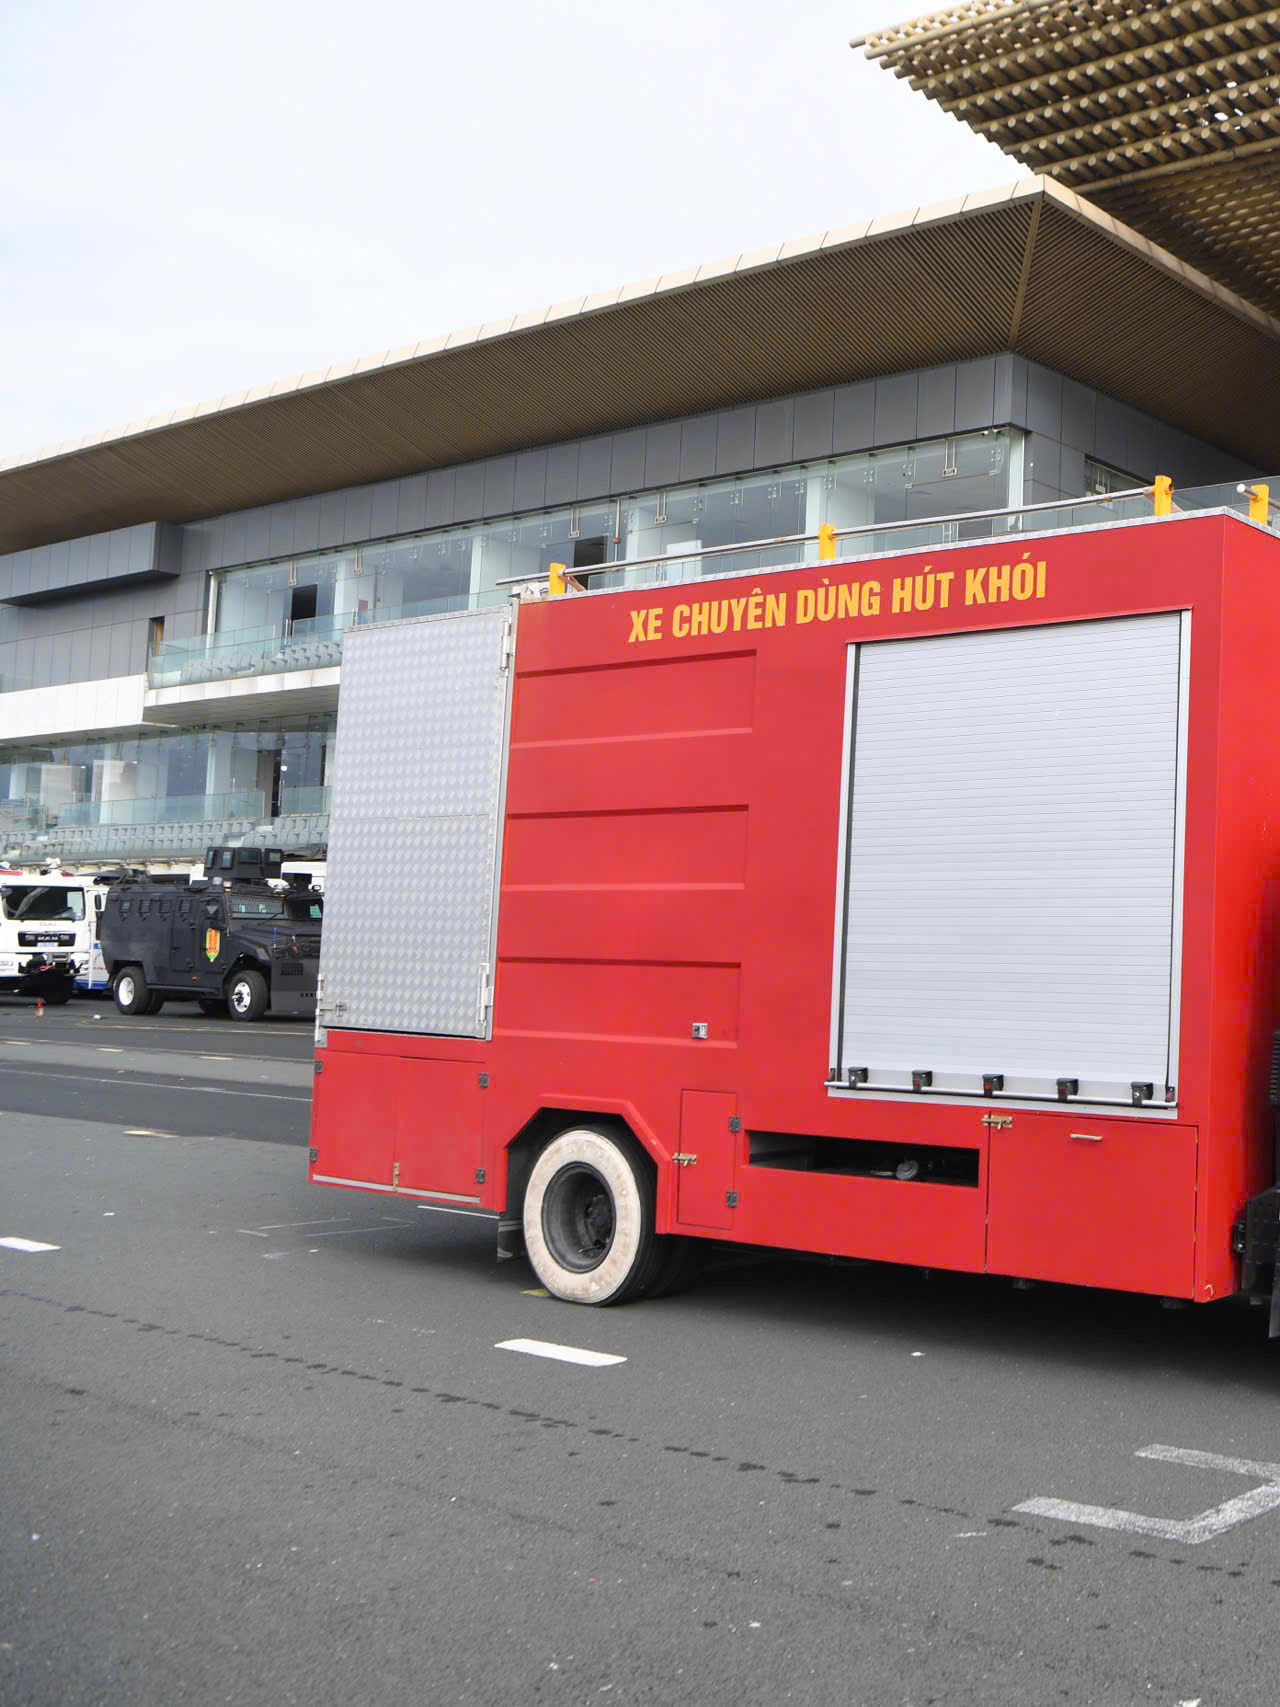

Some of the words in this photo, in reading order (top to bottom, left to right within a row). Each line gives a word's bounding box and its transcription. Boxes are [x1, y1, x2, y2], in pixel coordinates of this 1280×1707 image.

[628, 607, 662, 642] XE
[672, 587, 786, 638] CHUYÊN
[796, 578, 881, 624] DÙNG
[891, 565, 955, 613] HÚT
[965, 552, 1047, 605] KHÓI
